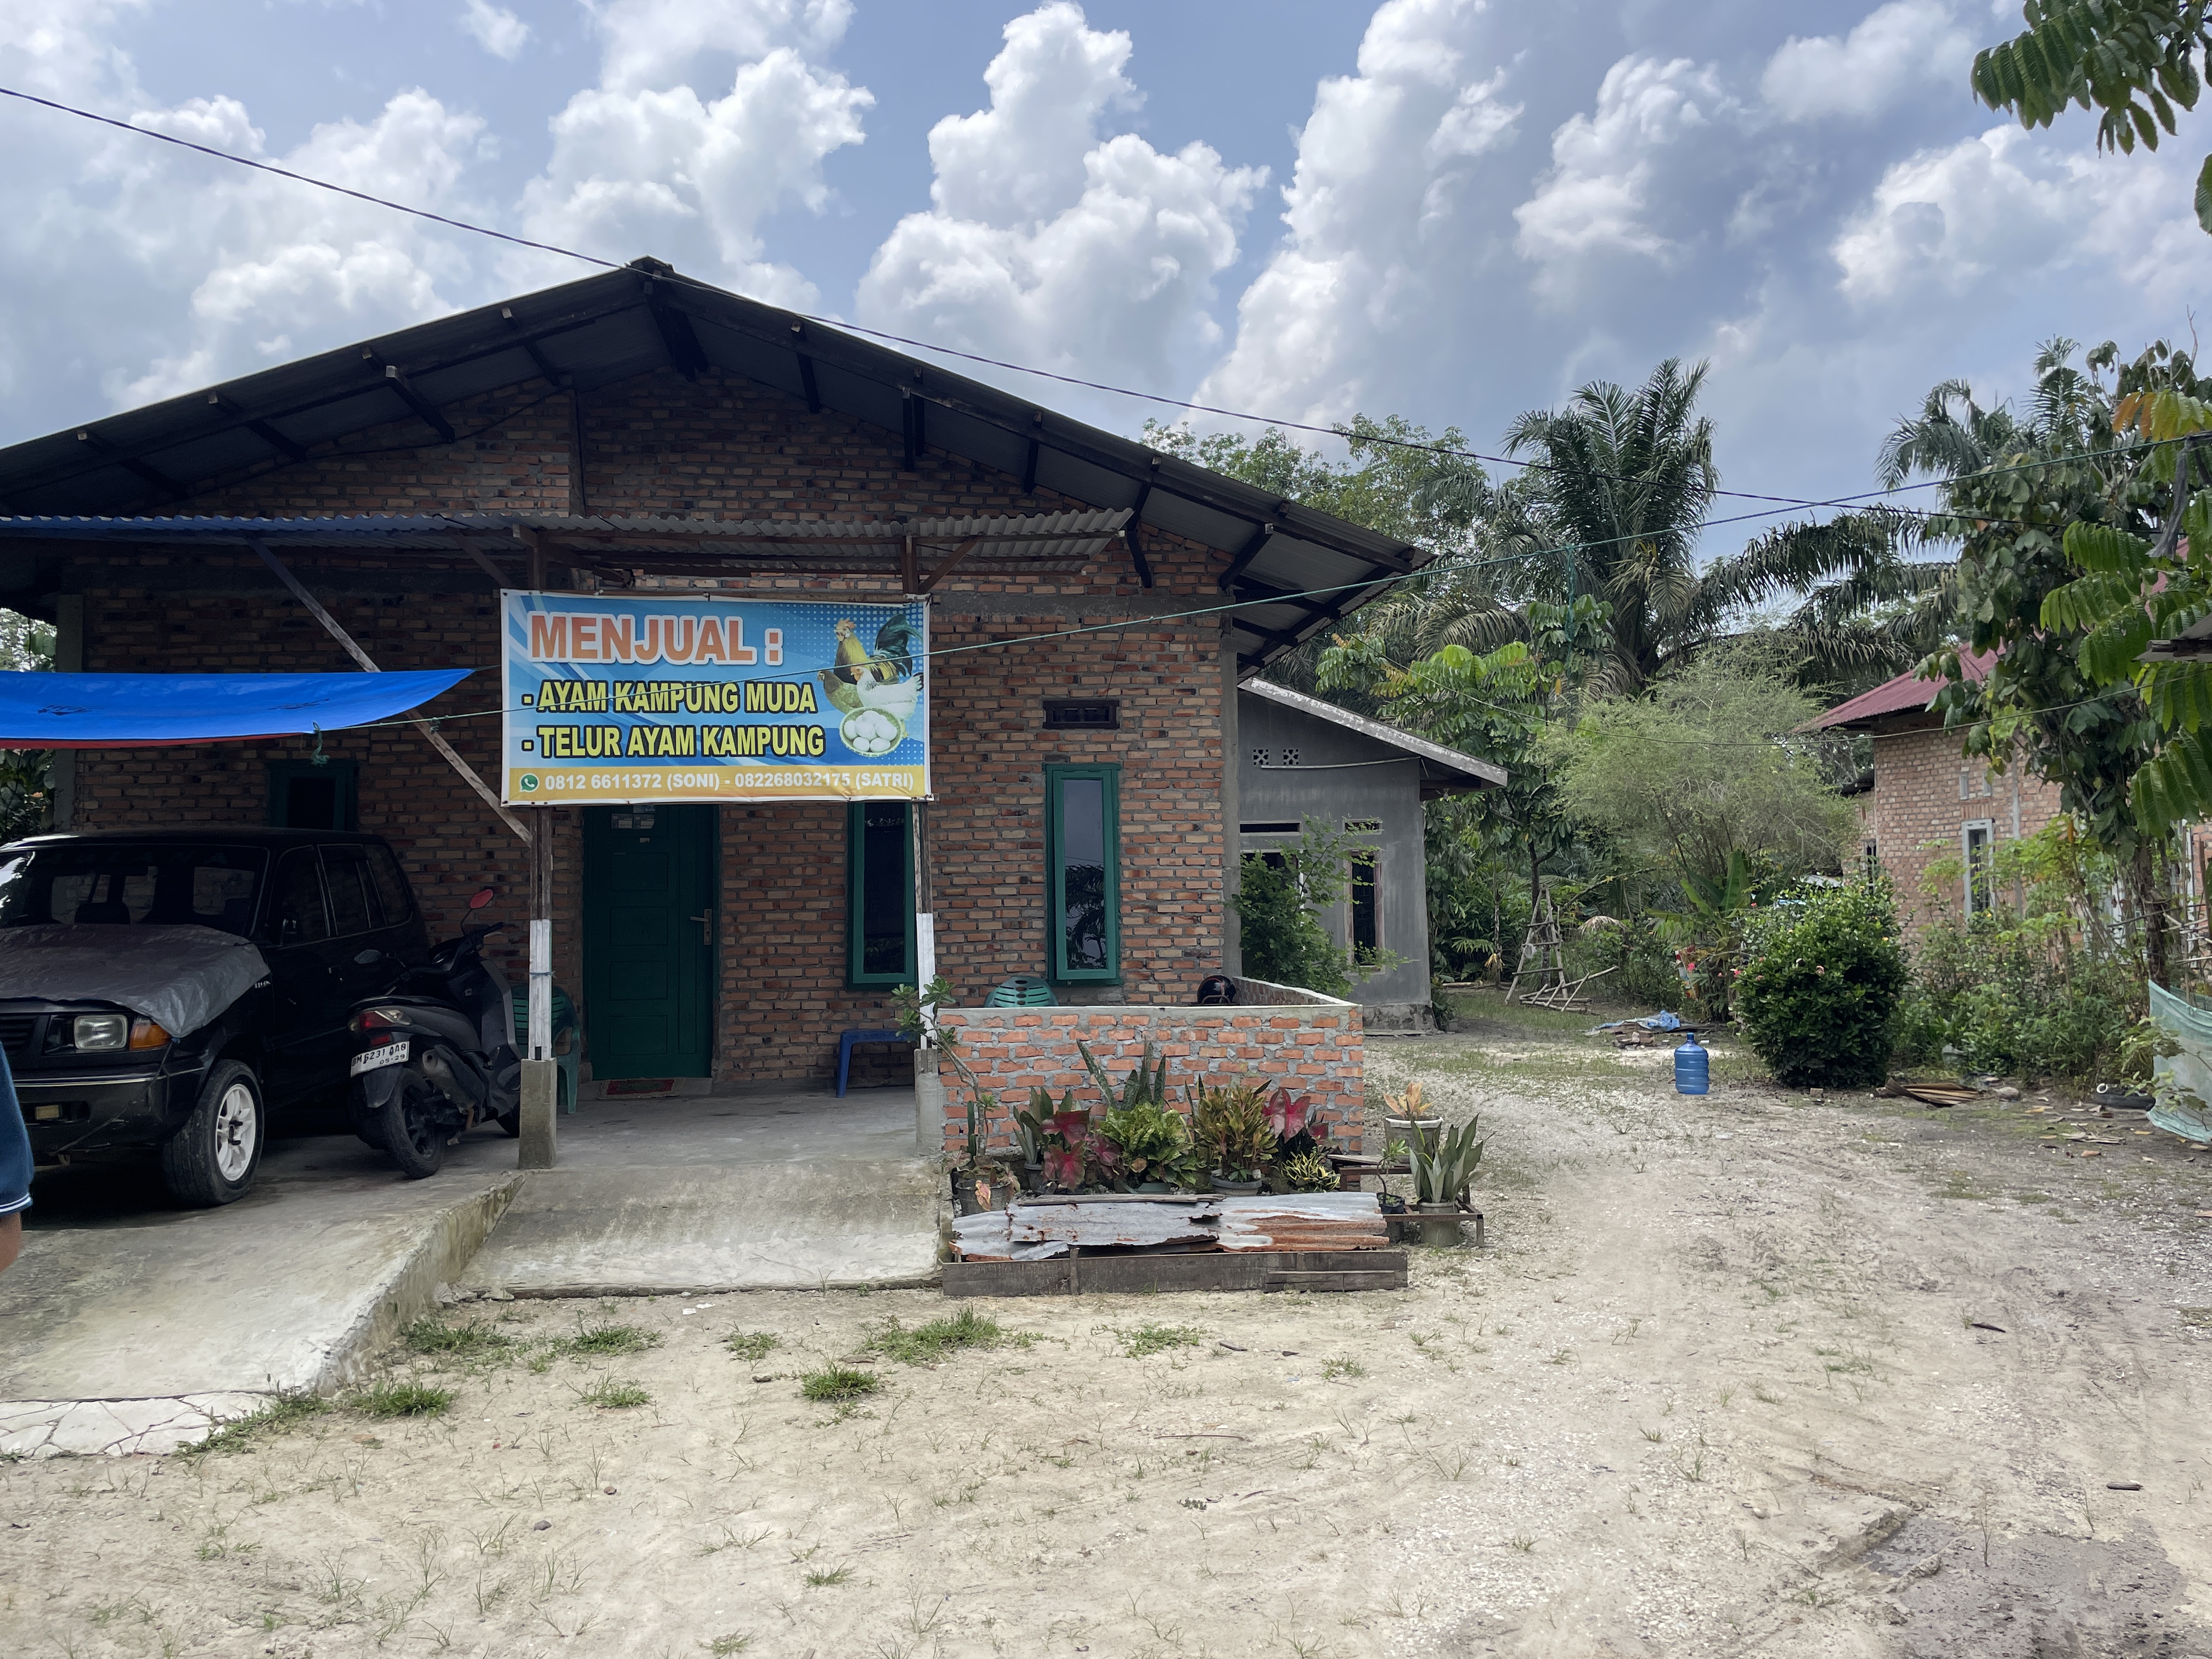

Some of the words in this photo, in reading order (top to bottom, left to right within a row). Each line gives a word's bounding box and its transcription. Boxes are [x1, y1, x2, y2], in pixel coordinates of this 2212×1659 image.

[531, 614, 754, 662] MENJUAL
[537, 681, 607, 712] AYAM
[614, 681, 739, 712] KAMPUNG
[745, 682, 817, 712] MUDA
[538, 726, 622, 757] TELUR
[627, 726, 695, 756] AYAM
[702, 726, 824, 756] KAMPUNG
[545, 775, 586, 790] 0812
[591, 774, 662, 789] 6611372
[667, 773, 720, 791] (SONI)
[735, 772, 850, 787] 082268032175
[856, 772, 913, 791] (SATRI)
[352, 1054, 363, 1067] BM
